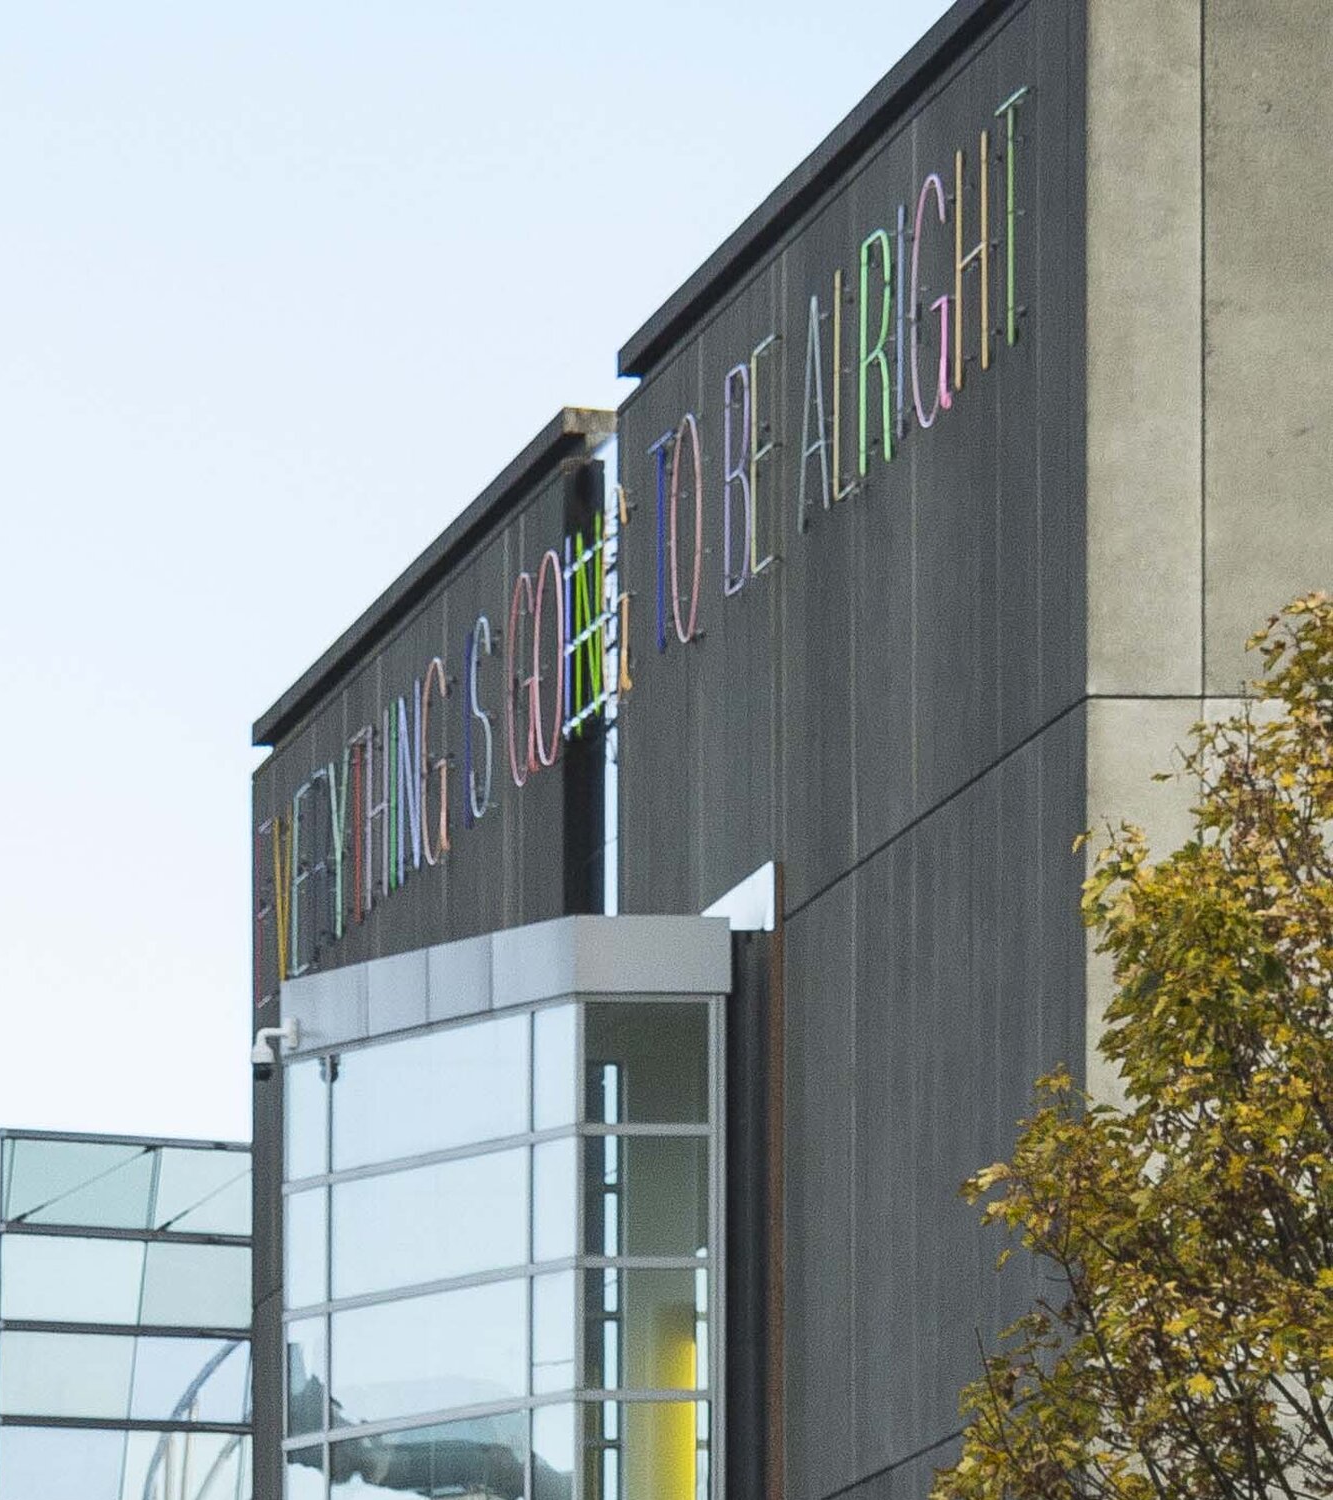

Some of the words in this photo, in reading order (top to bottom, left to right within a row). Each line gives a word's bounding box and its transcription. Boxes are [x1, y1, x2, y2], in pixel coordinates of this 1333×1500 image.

[256, 656, 451, 1010] EVERYTHING
[464, 614, 494, 832] IS
[507, 484, 633, 788] GOING
[646, 410, 703, 654] TO
[724, 332, 779, 598] BE
[797, 86, 1030, 537] ALRIGHT
